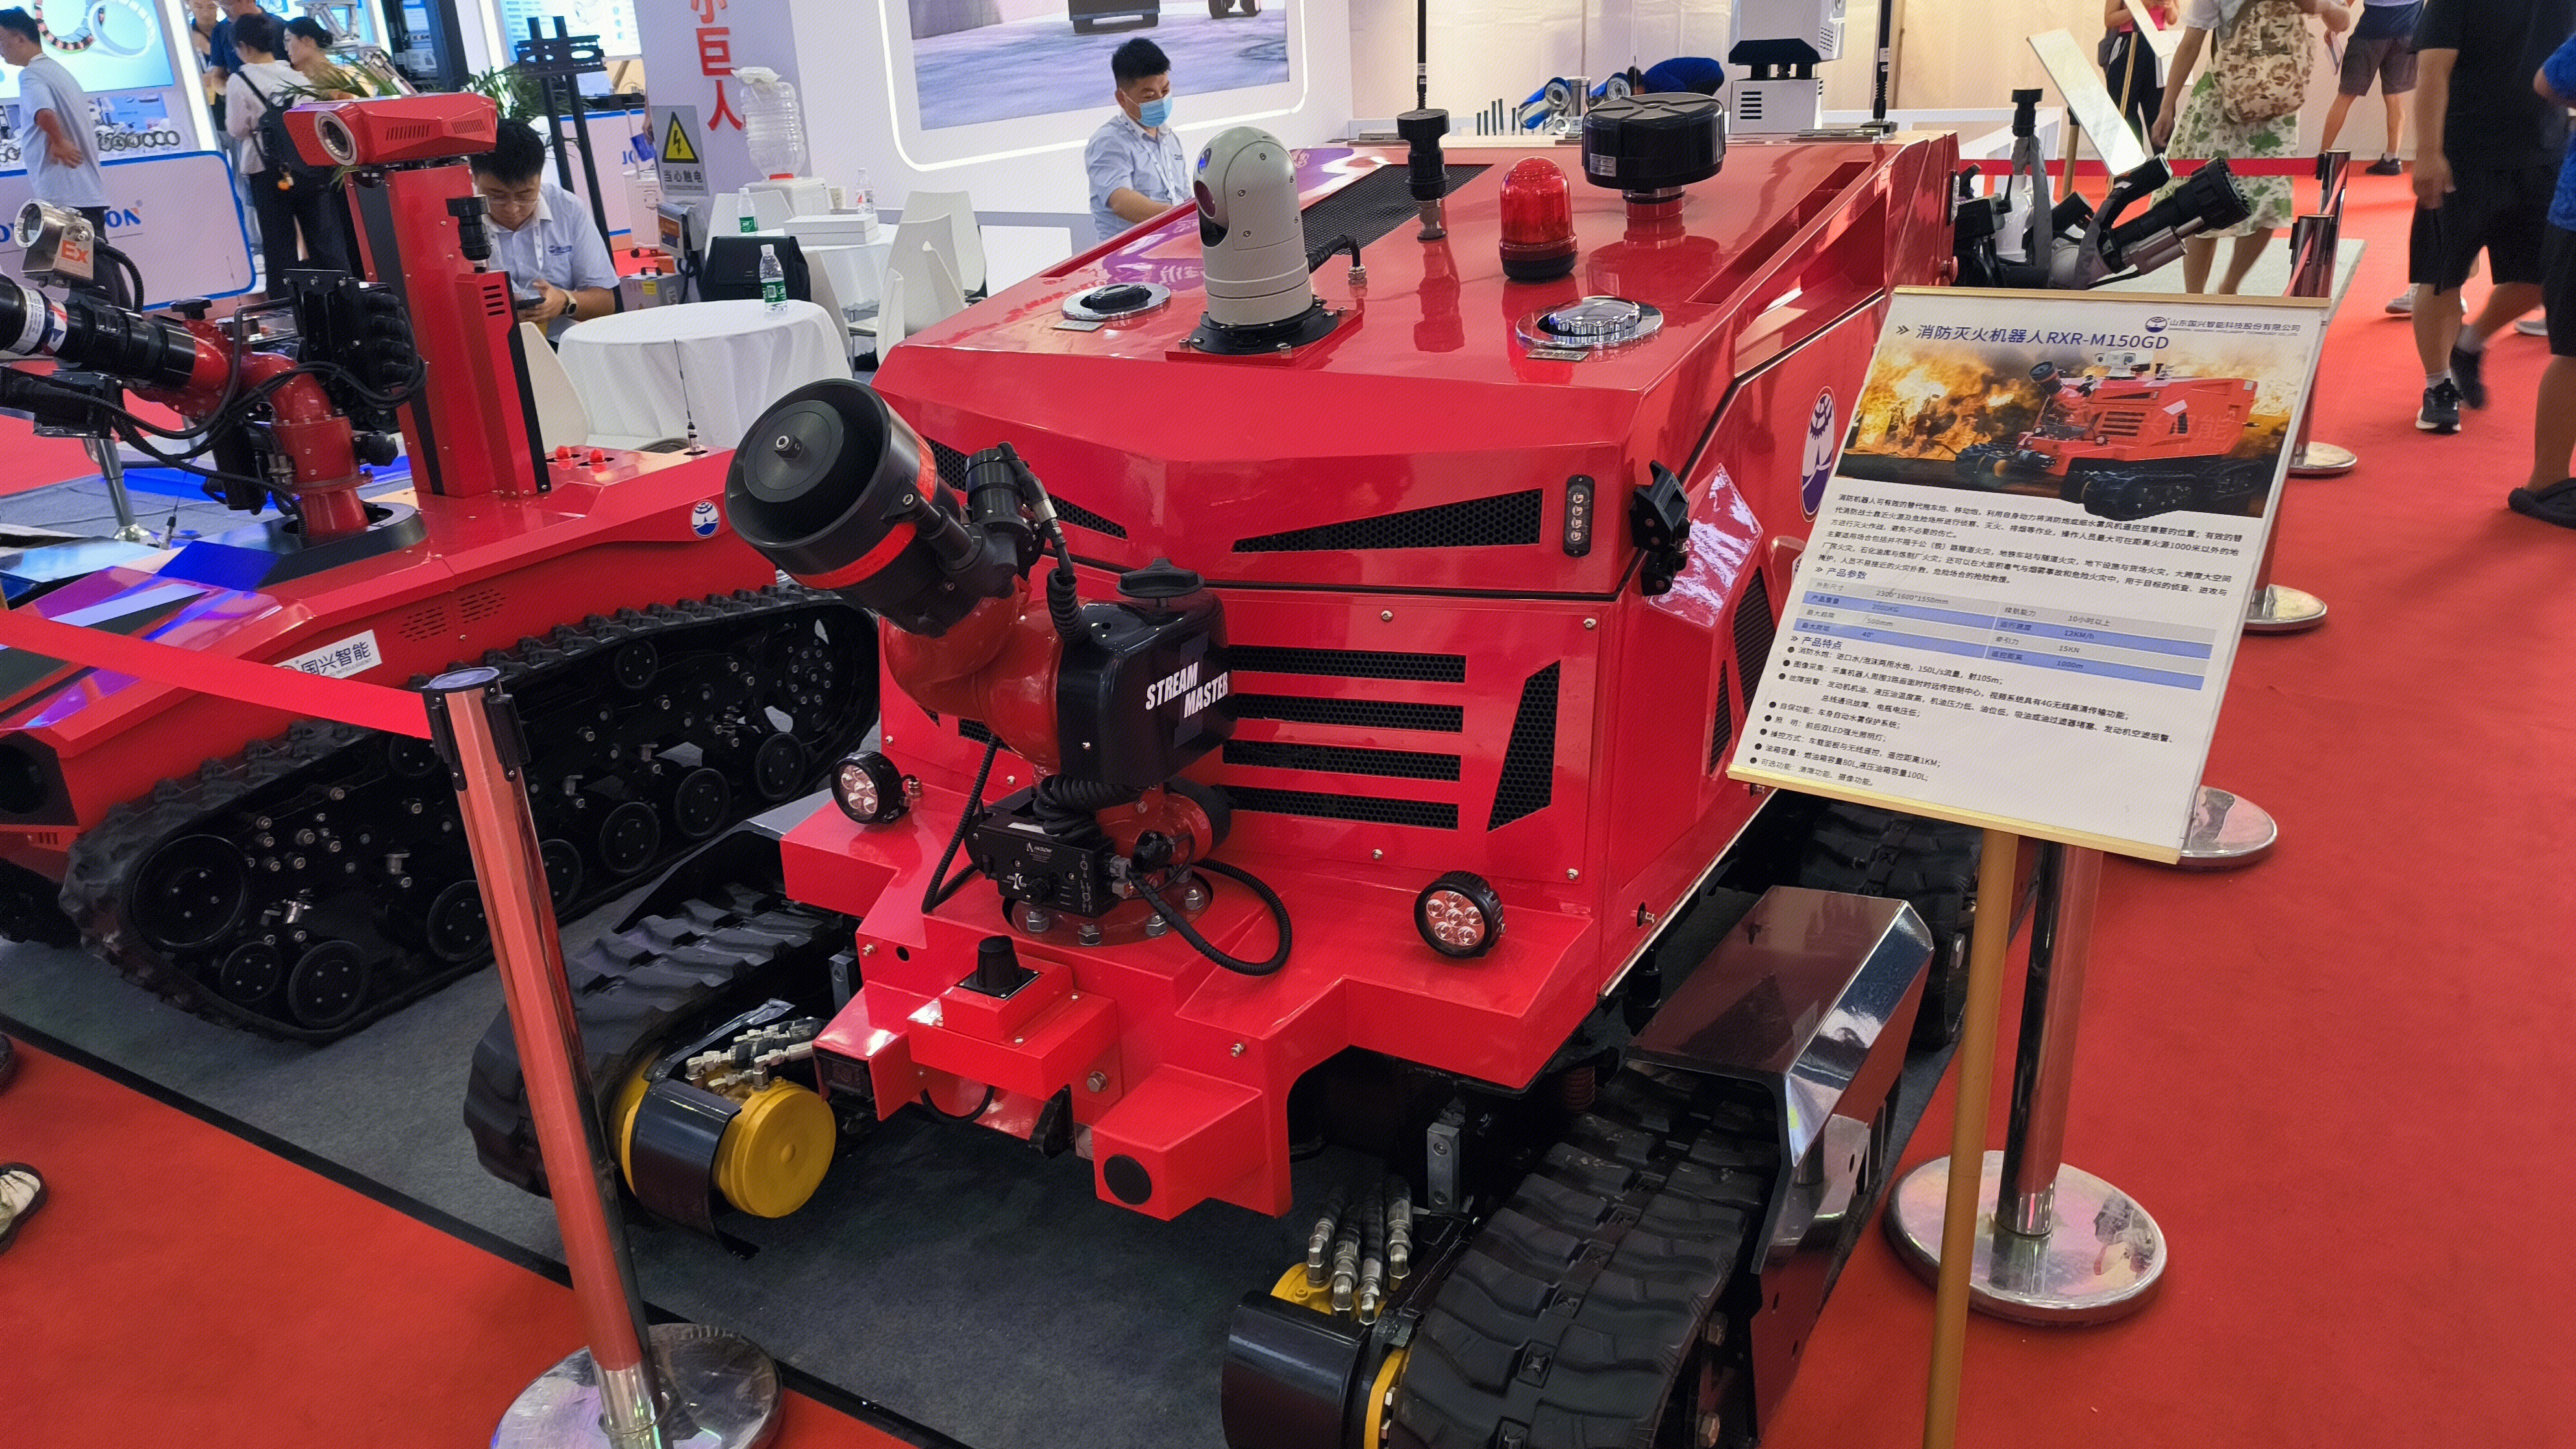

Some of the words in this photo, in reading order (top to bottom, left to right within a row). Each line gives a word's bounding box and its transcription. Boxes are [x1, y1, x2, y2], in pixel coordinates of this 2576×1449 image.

[60, 239, 90, 264] Ex
[2168, 318, 2301, 332] 山东国兴智能科技股份有限公司
[1914, 323, 2171, 353] 消防灭火机器人RXR-M150GD
[1825, 566, 1868, 580] 产品参数
[1814, 581, 1844, 592] 外形尺寸
[1810, 594, 1840, 604] 产品重量
[1865, 617, 1894, 627] 500mm
[1998, 621, 2033, 632] 运行速度
[2066, 614, 2112, 627] 10小时以上
[1994, 635, 2020, 645] 牵引力
[2063, 629, 2096, 640] 12KM/h
[1800, 635, 1844, 650] 产品特点
[2057, 644, 2080, 654] 15KN
[301, 641, 371, 675] 国兴智能
[1990, 650, 2024, 662] 遥控距离
[2055, 660, 2085, 670] 1000m
[1145, 662, 1199, 710] STREAM
[1184, 671, 1228, 719] MASTER
